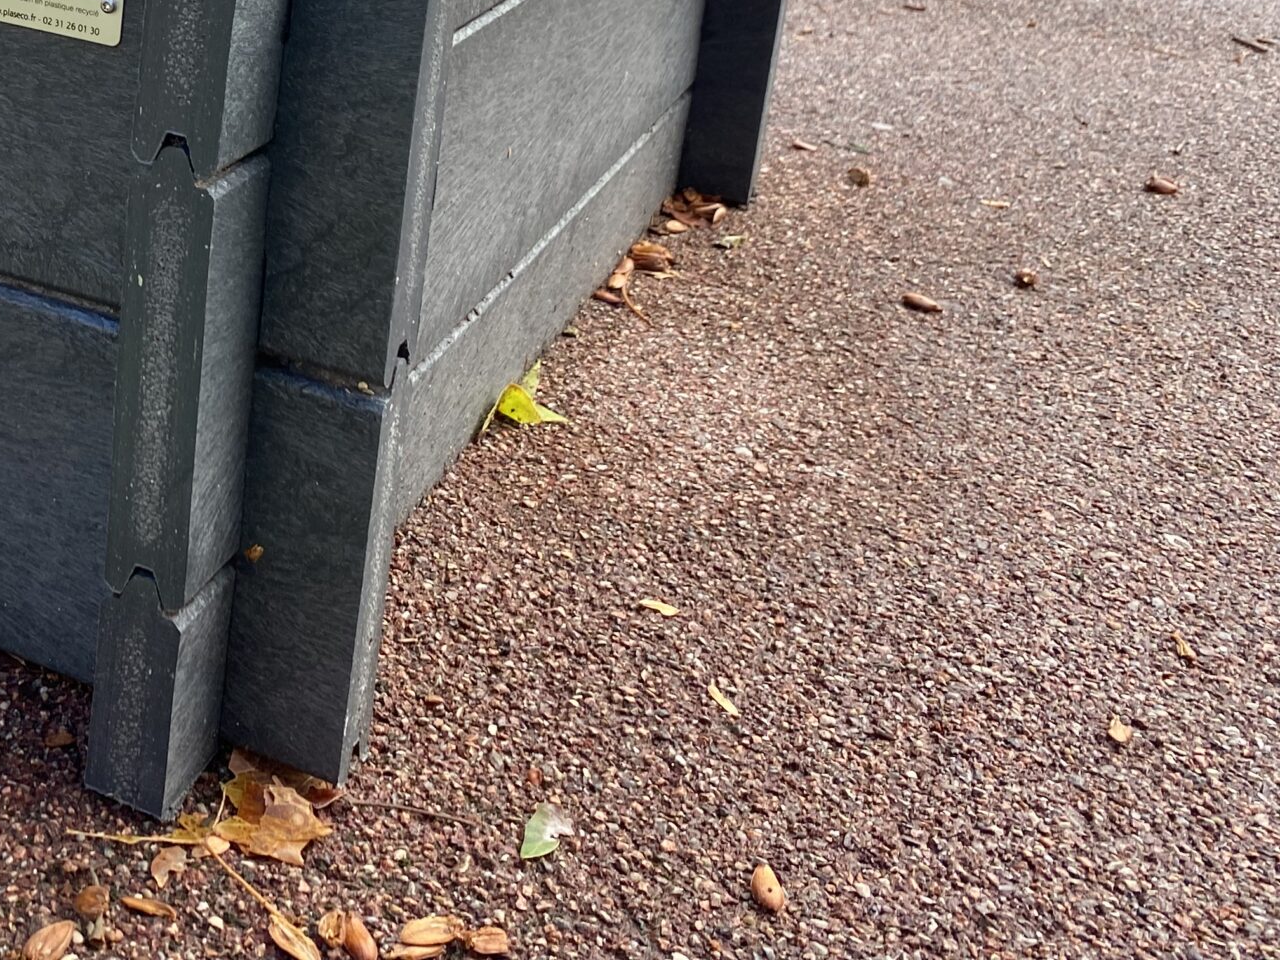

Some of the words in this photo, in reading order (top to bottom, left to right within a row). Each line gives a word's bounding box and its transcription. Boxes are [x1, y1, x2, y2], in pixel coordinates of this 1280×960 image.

[42, 16, 52, 26] 02
[55, 18, 63, 28] 31
[66, 21, 76, 31] 26
[77, 23, 87, 33] 01
[89, 26, 100, 36] 30
